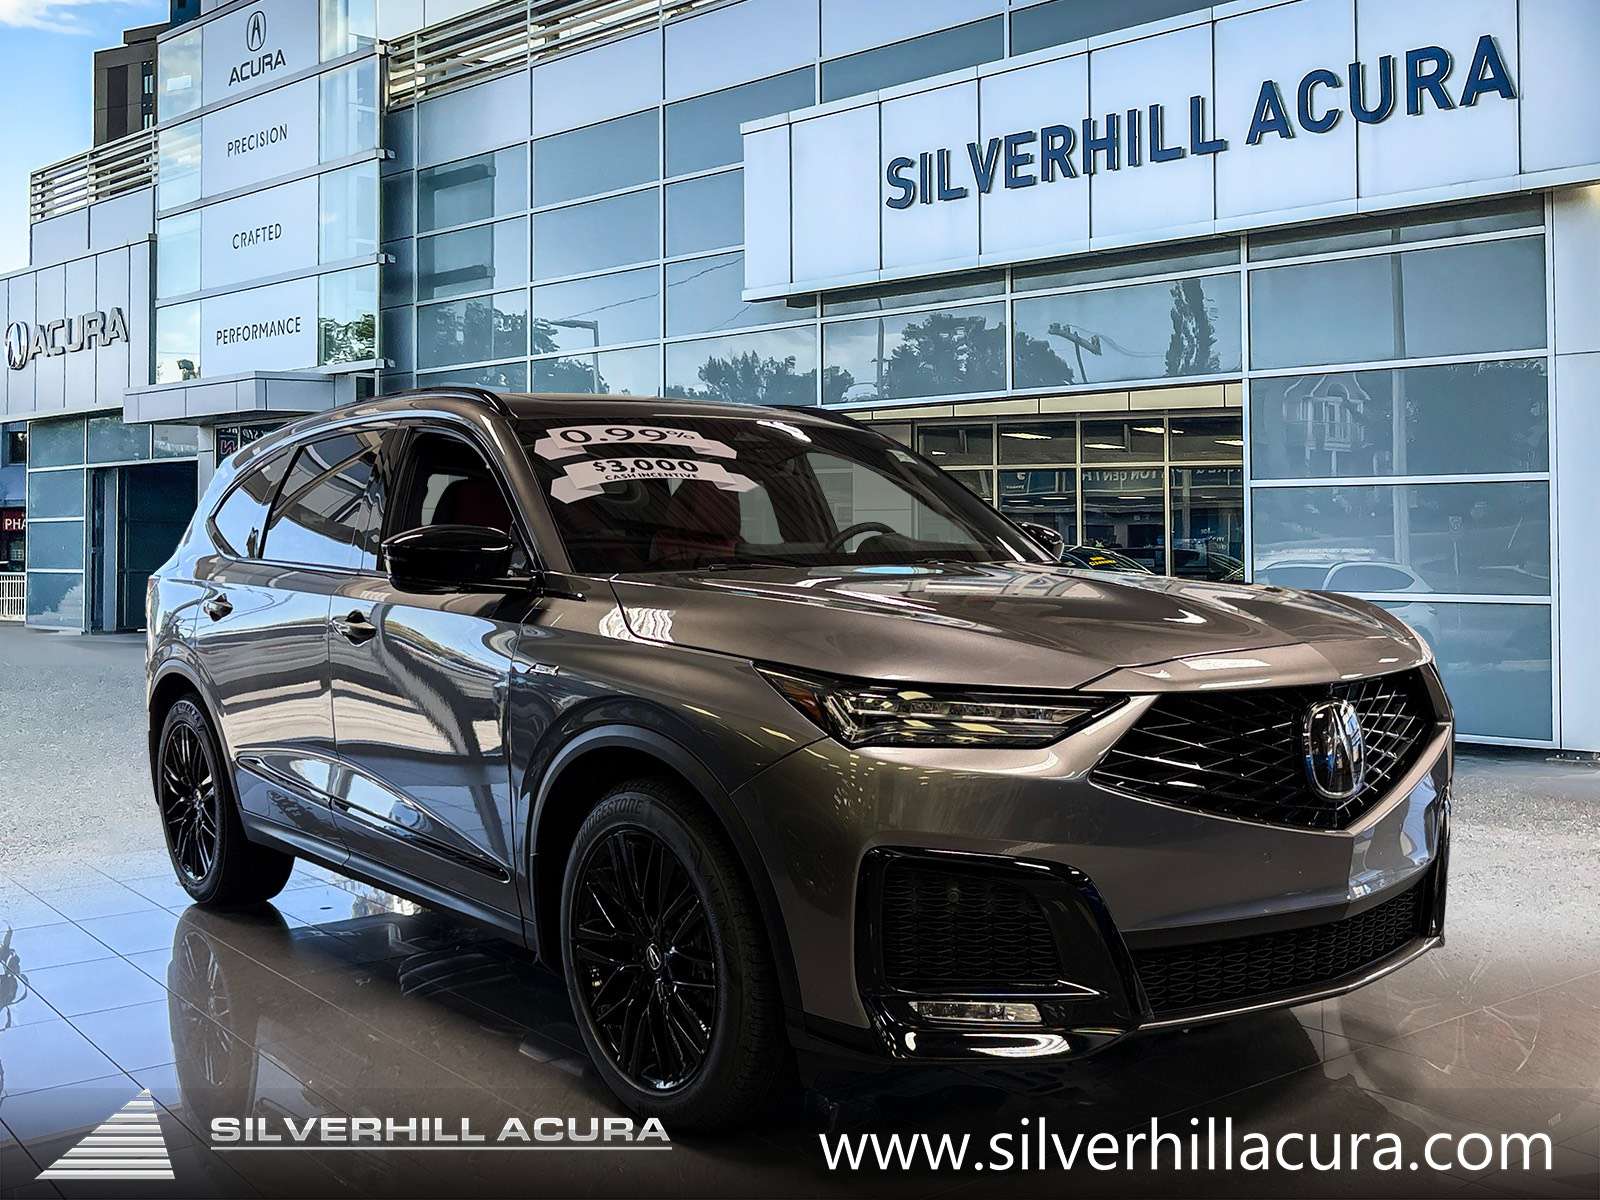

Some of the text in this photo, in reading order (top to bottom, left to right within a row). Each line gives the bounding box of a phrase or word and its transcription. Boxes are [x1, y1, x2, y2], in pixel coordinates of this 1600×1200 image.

[228, 50, 286, 87] ACURA
[885, 35, 1517, 209] SILVERHILL ACURA
[227, 124, 288, 157] PRECISION
[232, 223, 282, 250] CRAFTED
[28, 307, 129, 360] ACURA
[216, 316, 301, 346] PERFORMANCE
[559, 427, 695, 444] 0.99%
